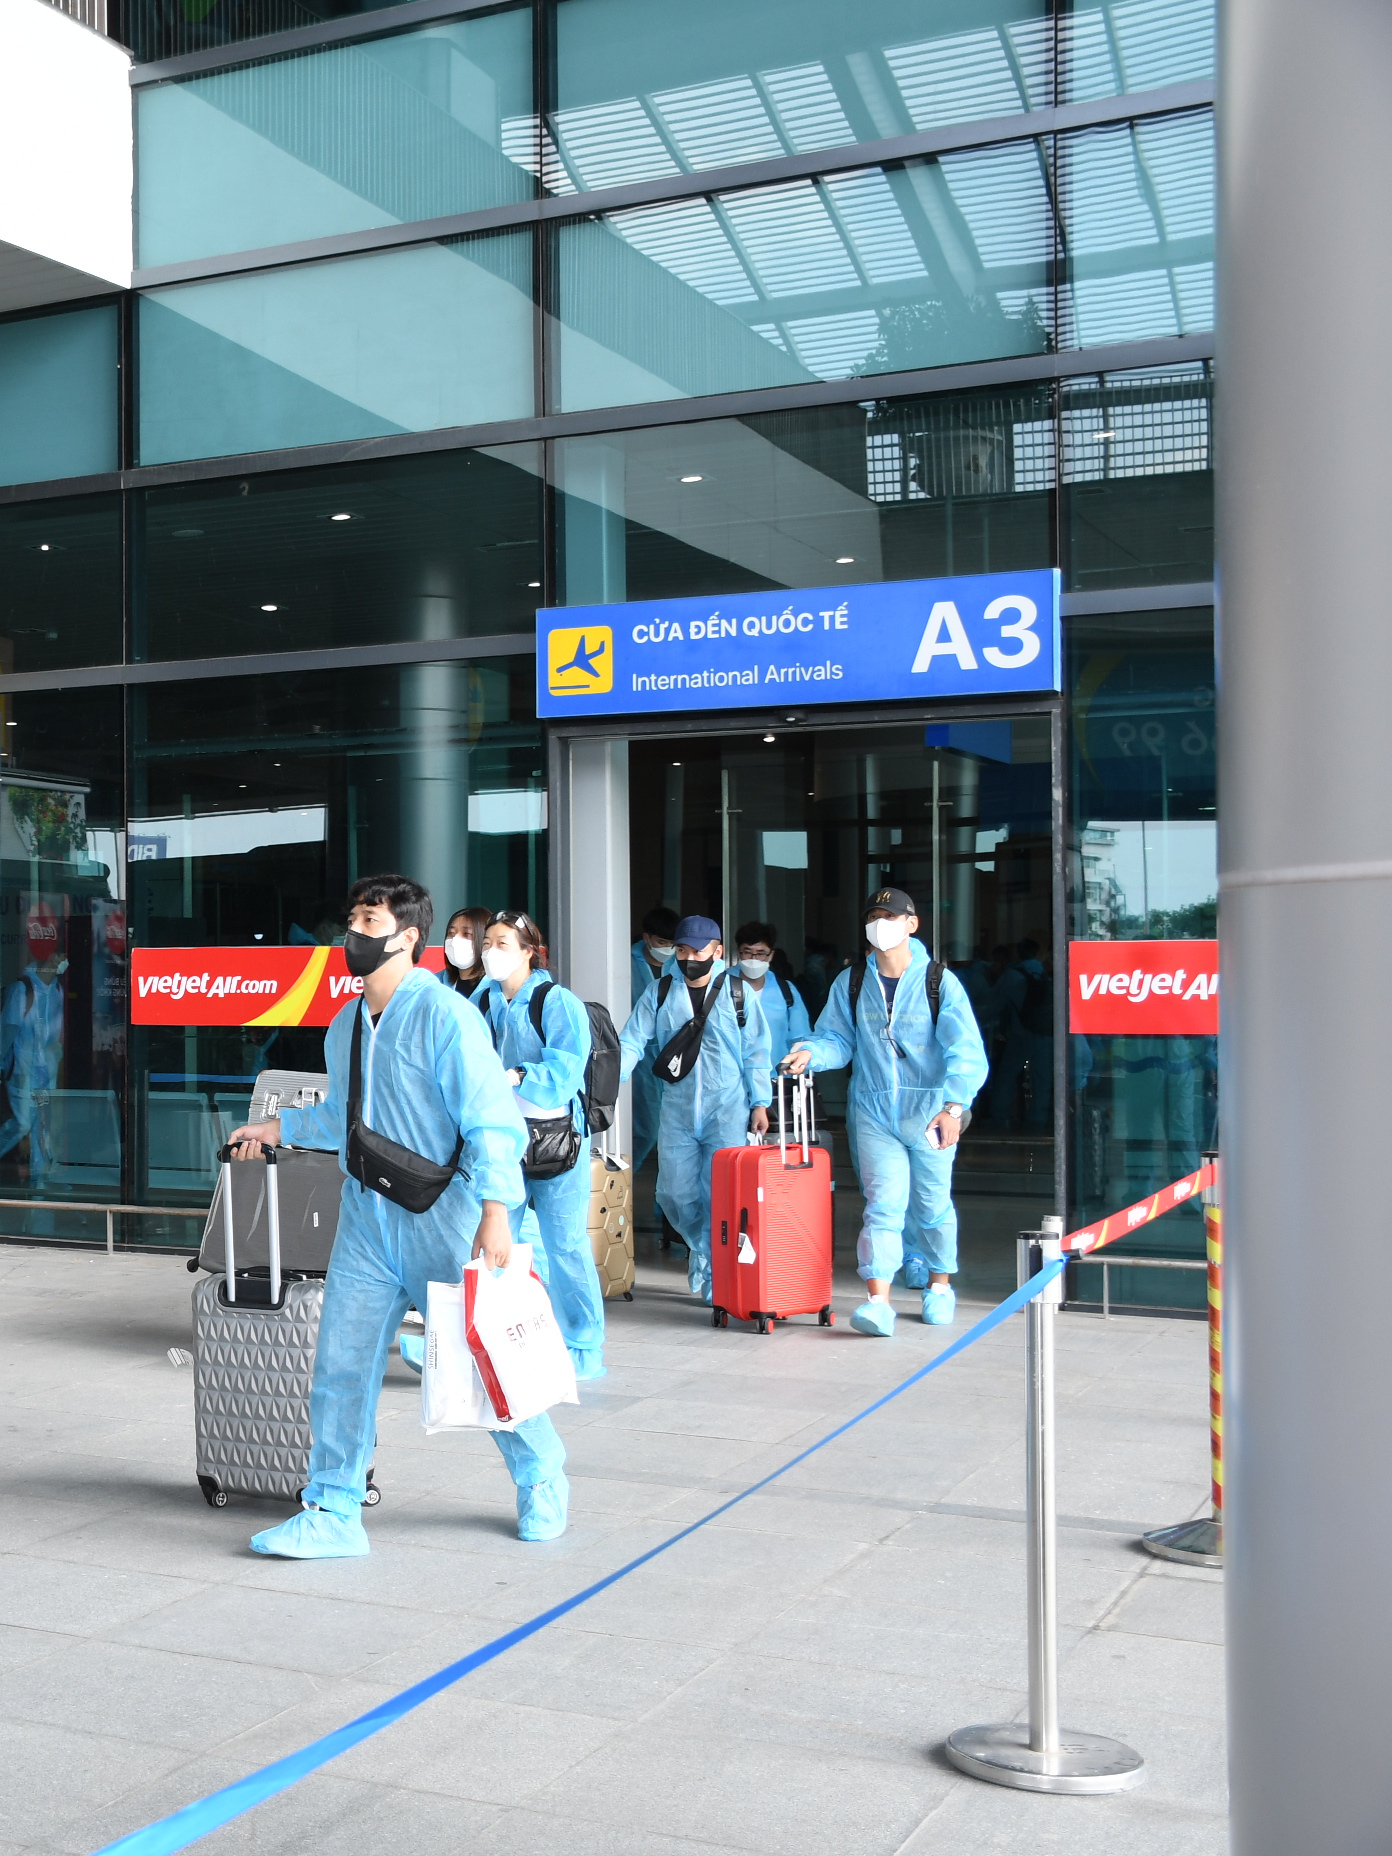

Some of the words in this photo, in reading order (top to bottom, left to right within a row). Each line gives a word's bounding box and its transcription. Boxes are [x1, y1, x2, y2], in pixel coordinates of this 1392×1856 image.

[632, 618, 684, 644] CỬA
[688, 611, 737, 640] ĐẾN
[742, 605, 814, 637] QUỐC
[819, 601, 849, 630] TẾ
[911, 594, 1041, 673] A3
[632, 664, 759, 692] International
[764, 660, 844, 684] Arrivals
